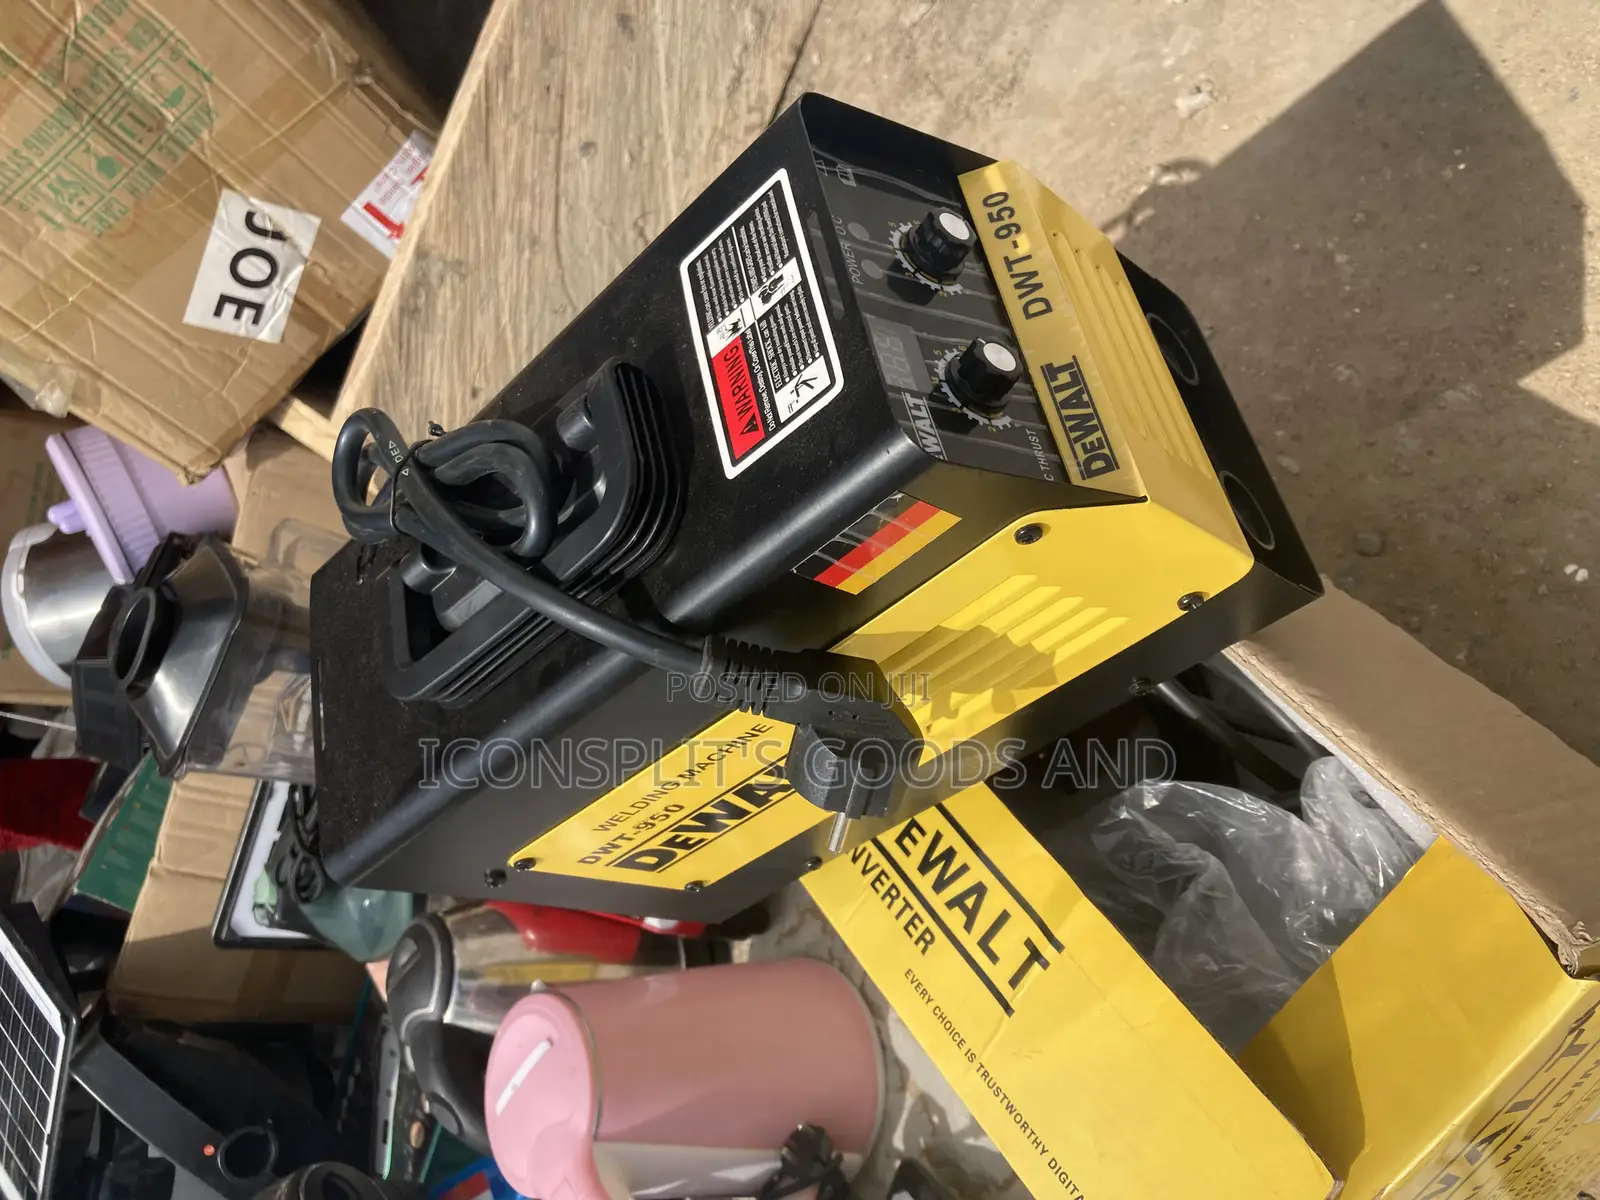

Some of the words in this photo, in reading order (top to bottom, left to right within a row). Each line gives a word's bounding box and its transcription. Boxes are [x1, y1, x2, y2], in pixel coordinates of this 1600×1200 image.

[213, 211, 288, 325] JOE
[840, 242, 864, 285] POWER
[982, 191, 1053, 320] DWT-950
[722, 342, 753, 421] WARNING
[906, 393, 943, 453] WALT
[1050, 361, 1115, 479] DEWALT
[1026, 429, 1047, 471] THRUST
[592, 780, 681, 832] WELDING
[676, 723, 774, 781] MACHINE
[613, 767, 795, 872] DEWA
[577, 803, 687, 865] DWT-950
[849, 845, 936, 956] NVERTER
[895, 816, 1051, 991] EWALT
[904, 968, 934, 1004] EVERY
[932, 1005, 966, 1050] CHOICE
[964, 1047, 977, 1064] IS
[975, 1062, 1049, 1157] TRUSTWORTHY
[1047, 1156, 1087, 1200] DIGITA
